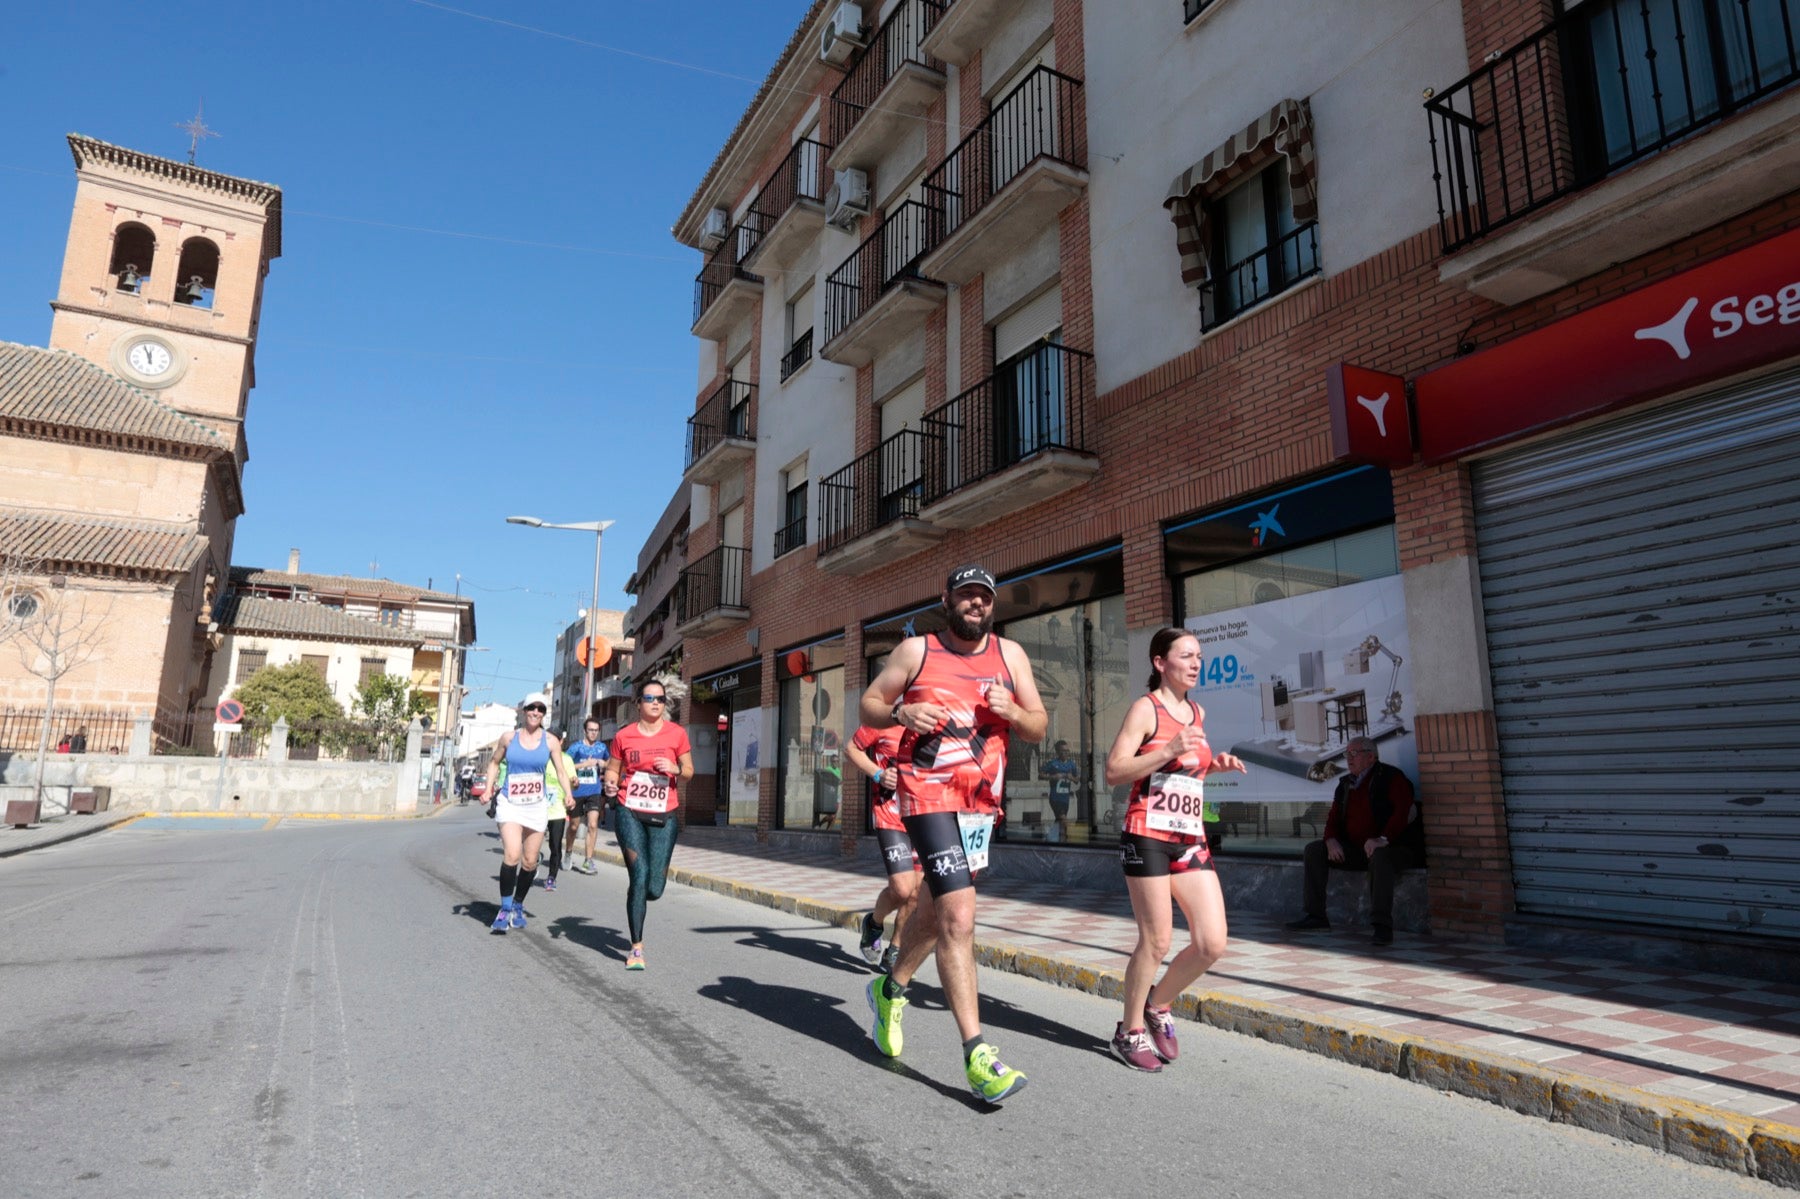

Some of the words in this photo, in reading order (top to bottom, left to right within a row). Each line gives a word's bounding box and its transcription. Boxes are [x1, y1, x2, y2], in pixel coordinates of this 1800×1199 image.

[1710, 281, 1800, 339] Seg
[1192, 626, 1218, 636] Renueva
[1219, 624, 1227, 632] tu
[1227, 621, 1248, 631] hogar,
[1226, 630, 1248, 639] ilusión
[1200, 654, 1238, 687] 149
[510, 782, 542, 796] 2229
[629, 783, 666, 800] 2266
[1152, 790, 1201, 817] 2088
